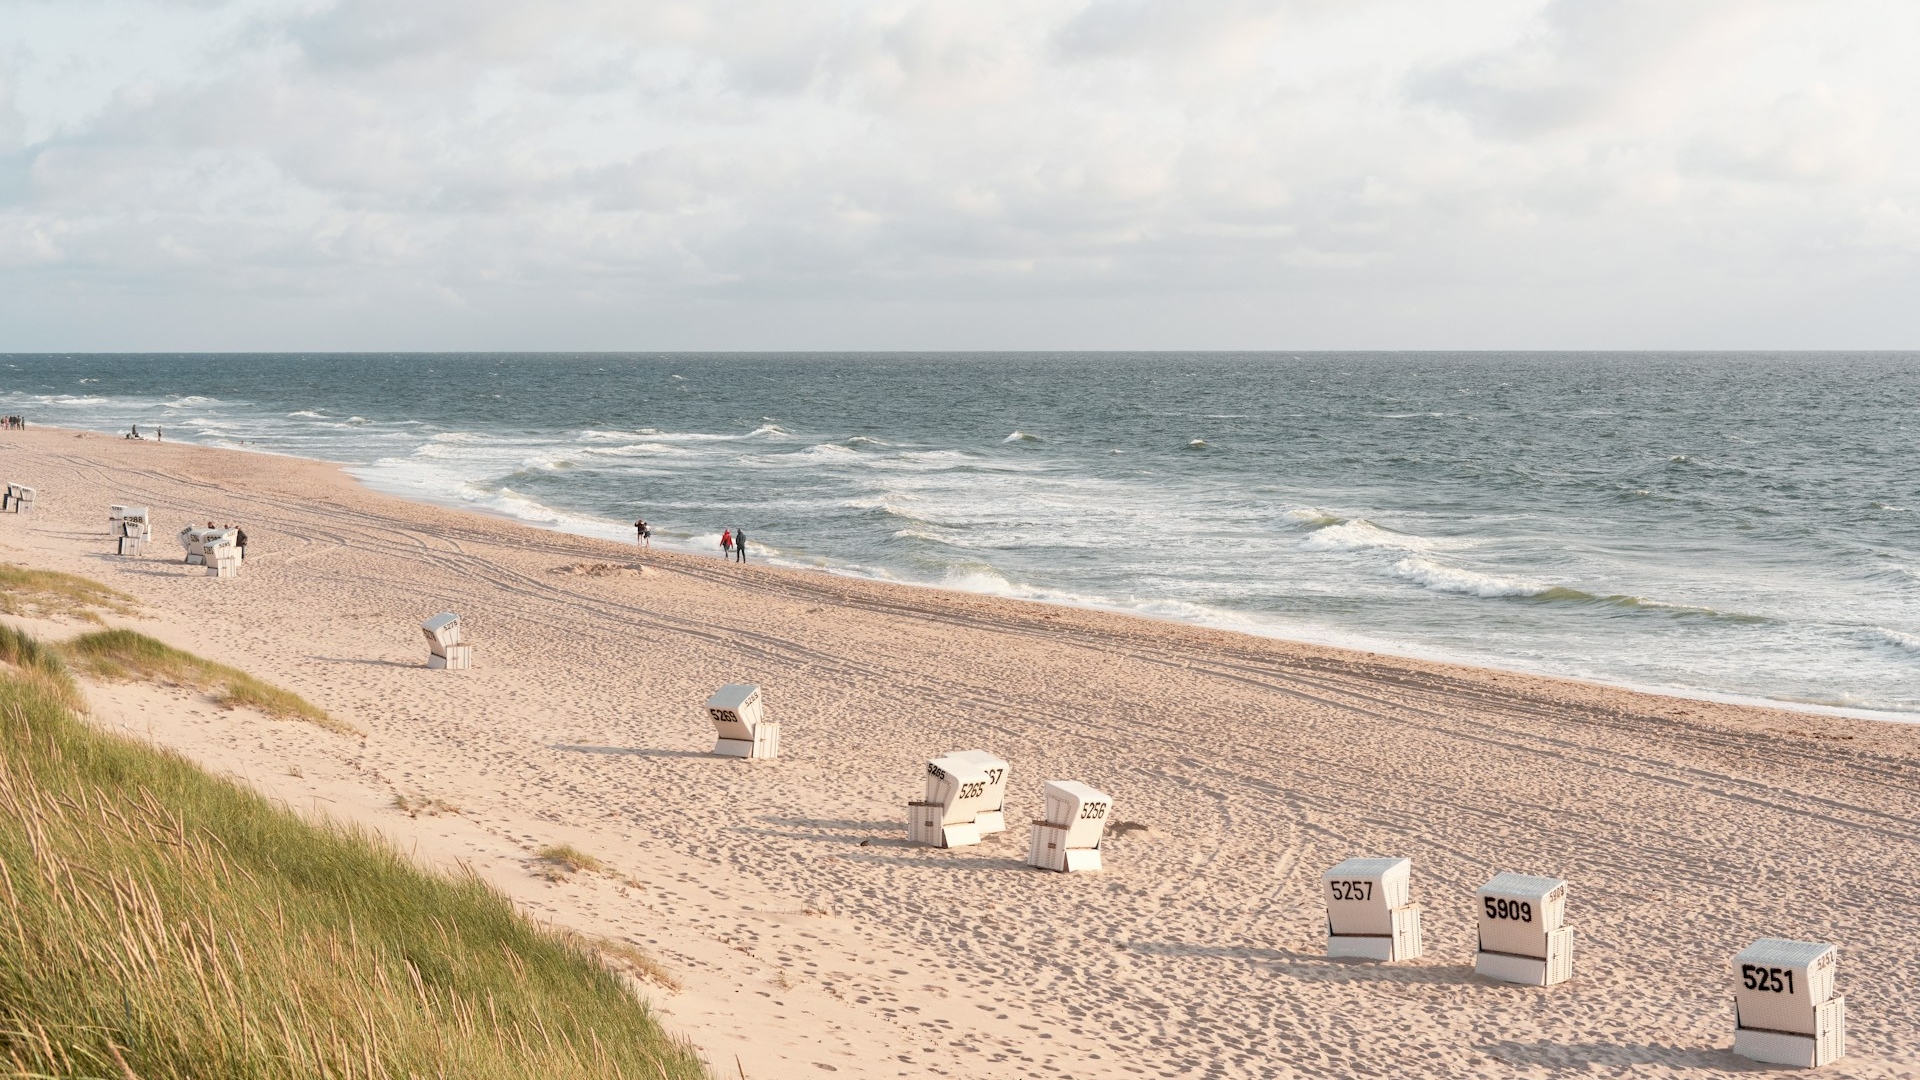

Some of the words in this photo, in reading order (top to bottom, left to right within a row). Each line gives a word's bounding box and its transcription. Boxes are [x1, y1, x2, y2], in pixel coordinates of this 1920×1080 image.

[710, 708, 738, 722] 5269
[927, 763, 945, 780] 5265
[960, 782, 986, 799] 5265
[1080, 802, 1107, 820] 5256
[1331, 880, 1372, 900] 5257
[1550, 885, 1564, 902] 5909
[1484, 896, 1532, 922] 5909
[1817, 951, 1834, 970] 5251
[1742, 964, 1794, 994] 5251
